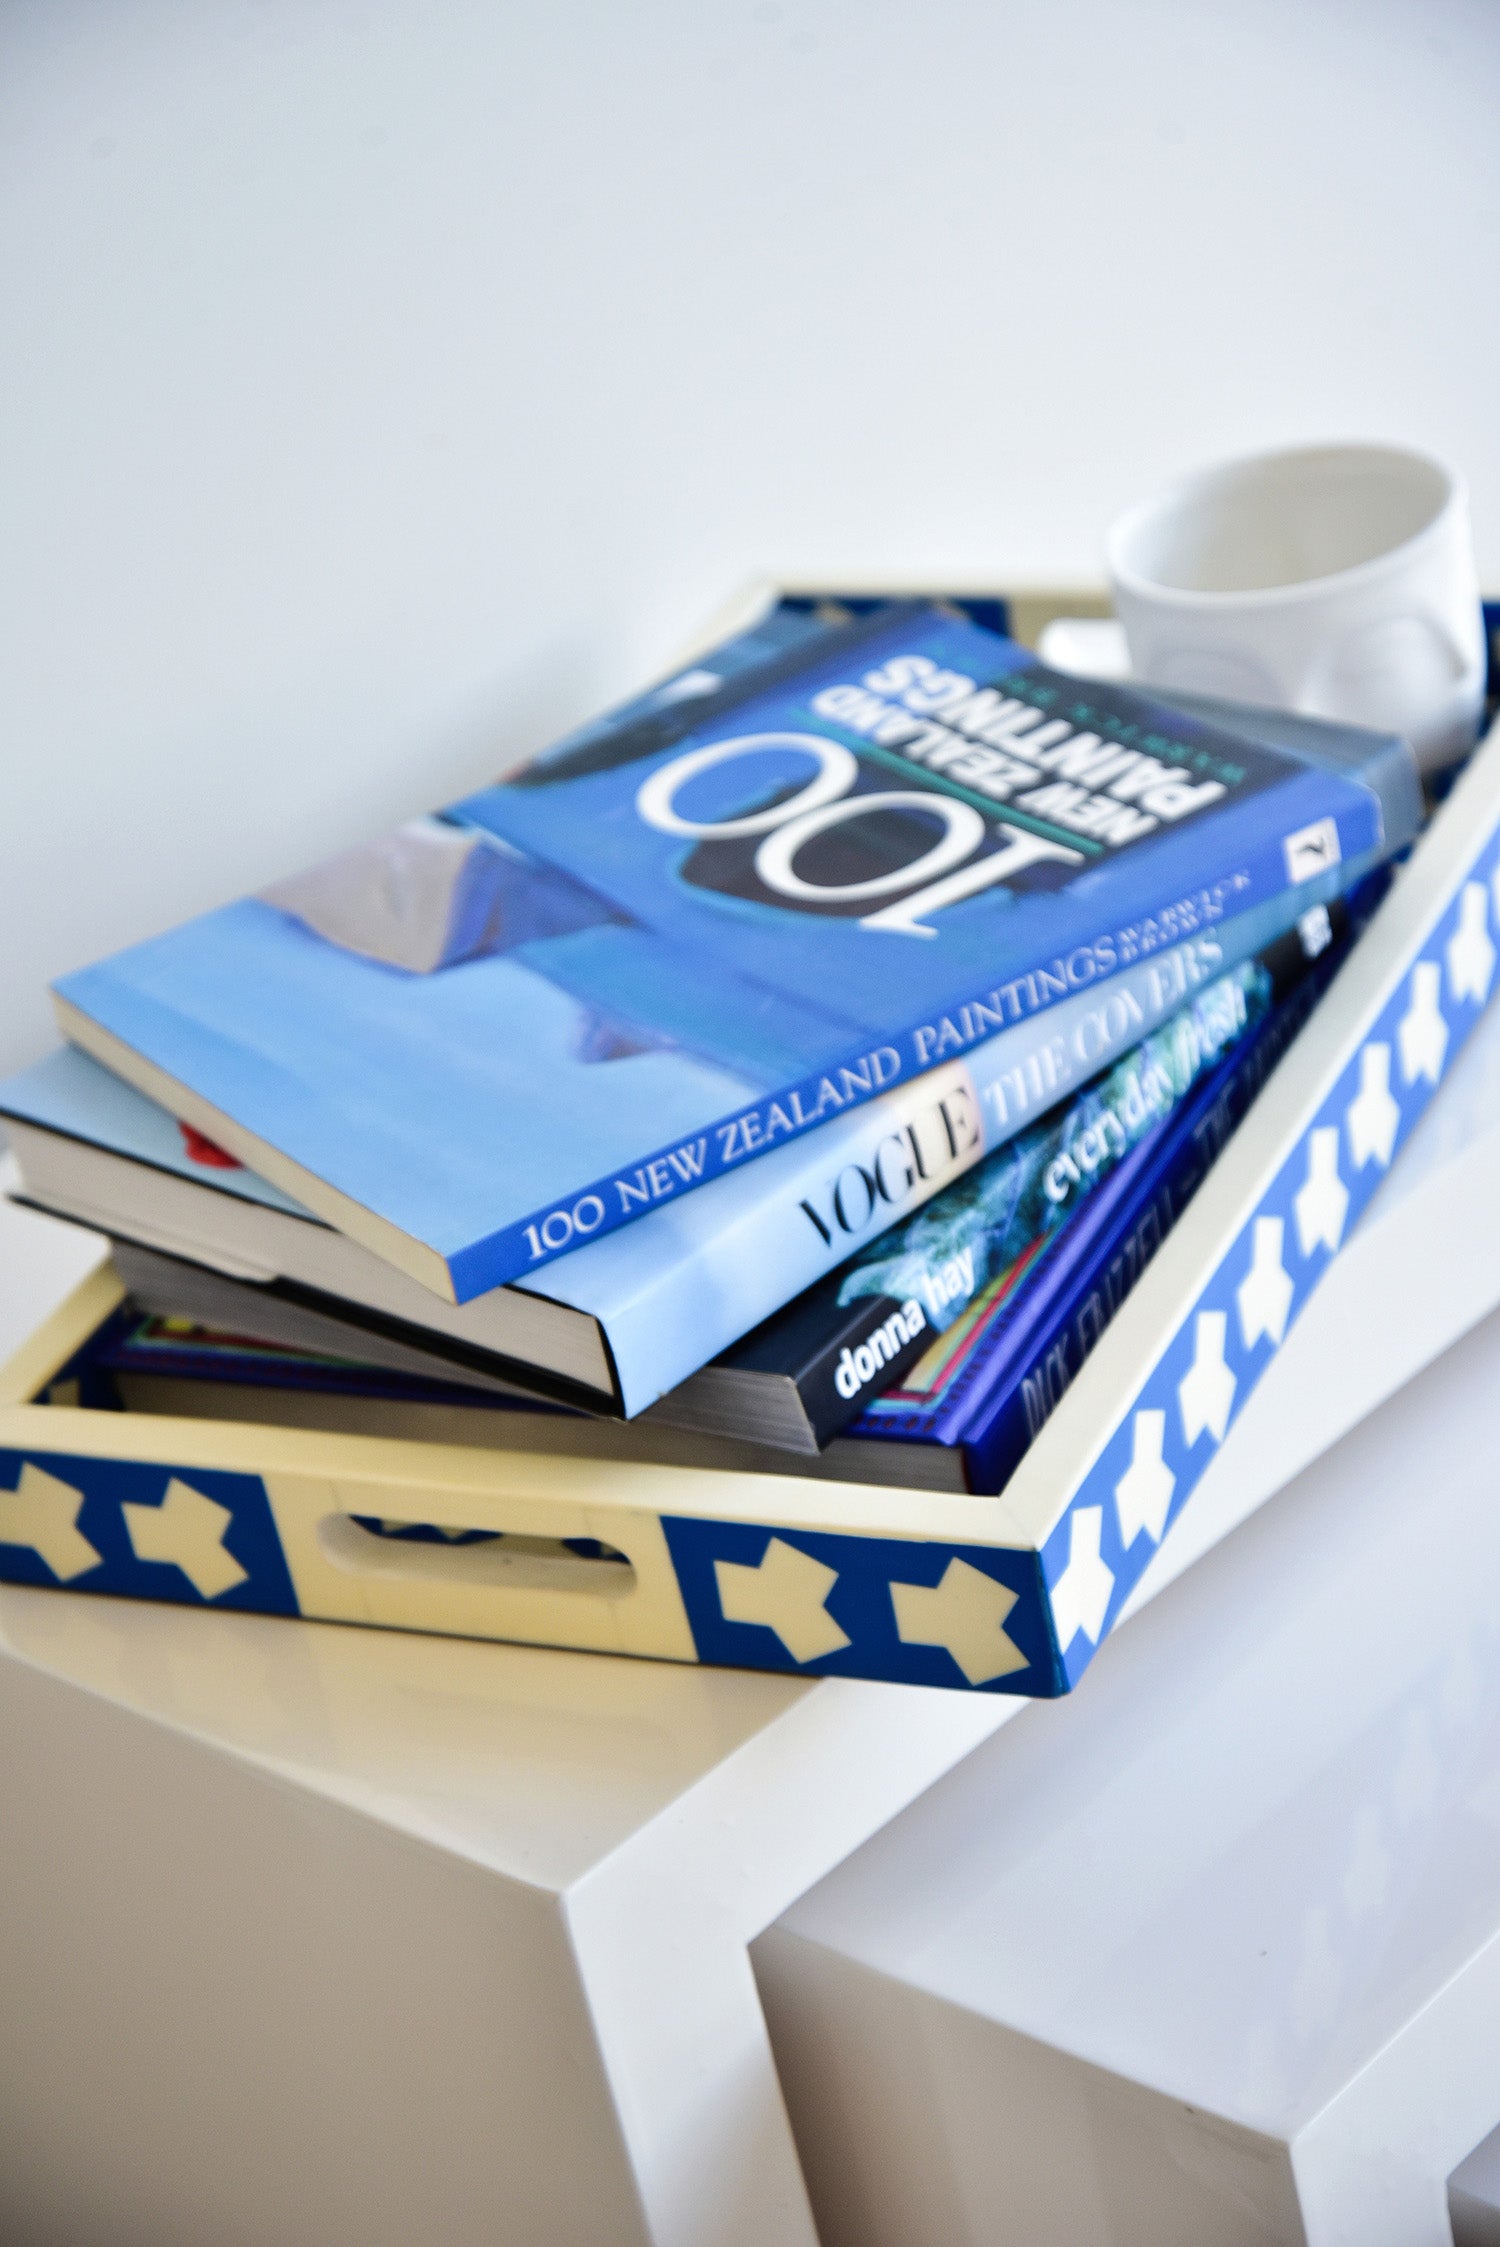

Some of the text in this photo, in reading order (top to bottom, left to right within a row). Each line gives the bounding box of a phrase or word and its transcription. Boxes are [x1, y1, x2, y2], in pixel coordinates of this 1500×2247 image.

[811, 685, 1043, 799] ZEALAND
[862, 655, 1228, 822] PAINTINGS
[1016, 777, 1159, 849] NEW
[637, 731, 1086, 940] 100
[521, 935, 1118, 1261] 100 NEW ZEALAND PAINTINGS
[797, 1086, 982, 1248] VOGUE
[984, 1038, 1073, 1128] THE
[1073, 929, 1224, 1063] COVERS
[834, 1299, 926, 1400] donna
[922, 1246, 974, 1306] hay
